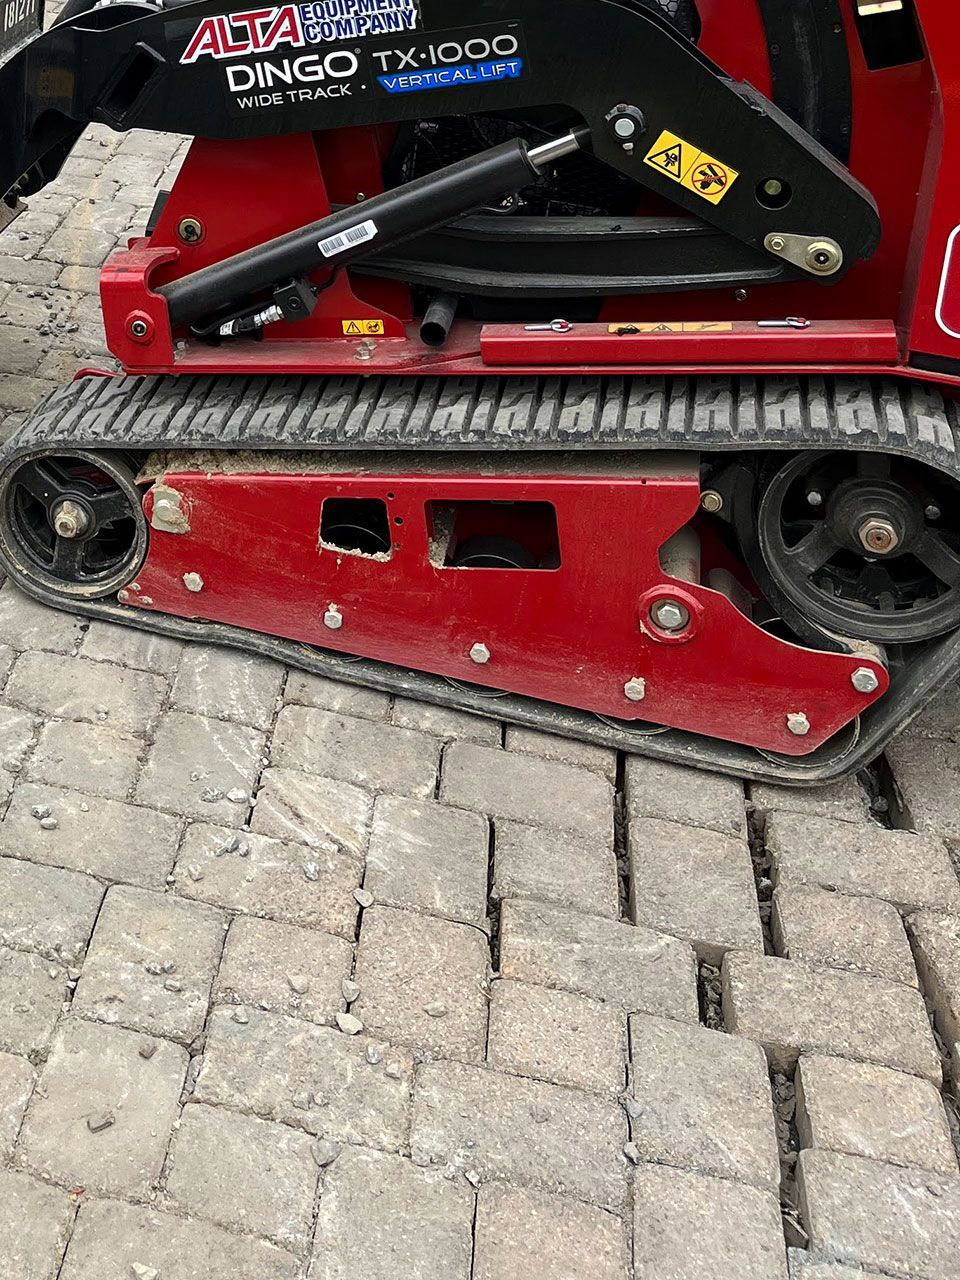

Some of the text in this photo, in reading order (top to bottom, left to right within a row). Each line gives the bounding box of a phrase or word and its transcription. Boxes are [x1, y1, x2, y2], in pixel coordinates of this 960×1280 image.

[179, 4, 305, 64] ALTA
[304, 8, 417, 43] COMPANY
[237, 62, 518, 109] WIDE TRACK VERTICAL LIFT
